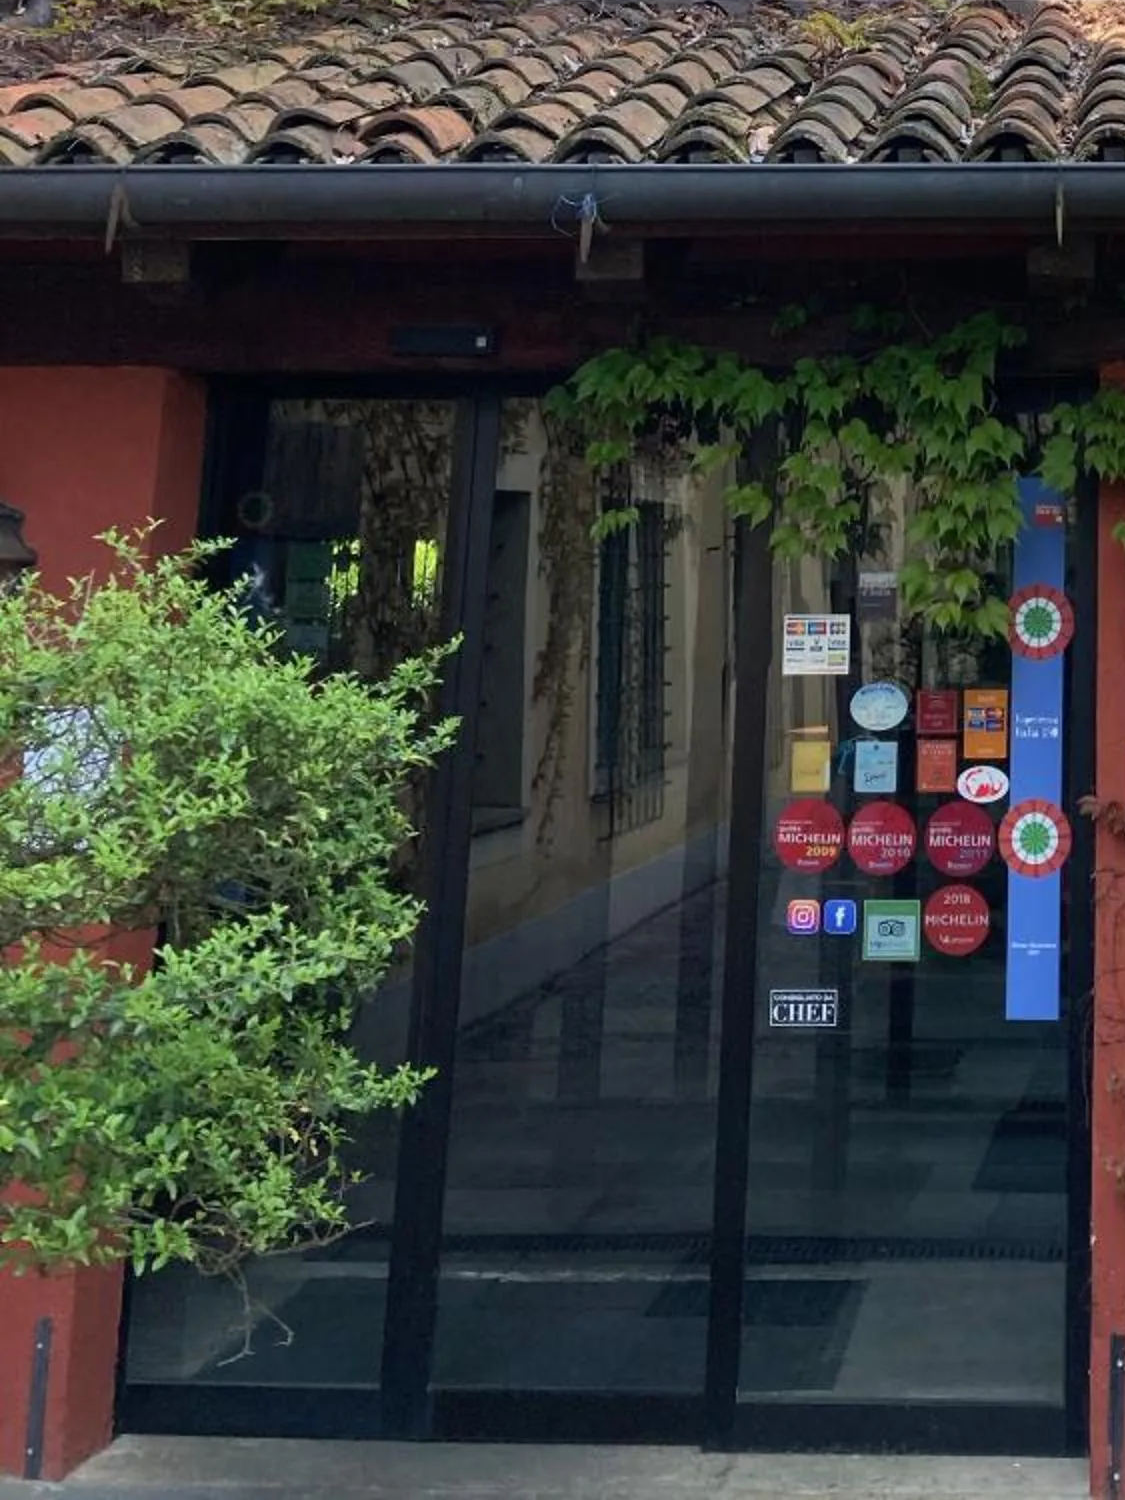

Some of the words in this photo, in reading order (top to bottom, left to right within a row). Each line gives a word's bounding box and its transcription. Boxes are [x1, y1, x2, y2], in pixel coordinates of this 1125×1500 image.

[778, 832, 841, 844] MICHELIN
[851, 833, 913, 846] MICHELIN
[929, 834, 991, 847] MICHELIN
[805, 845, 837, 857] 2009
[943, 893, 971, 905] 2018
[925, 914, 990, 926] MICHELIN
[773, 1003, 835, 1022] CHEF
